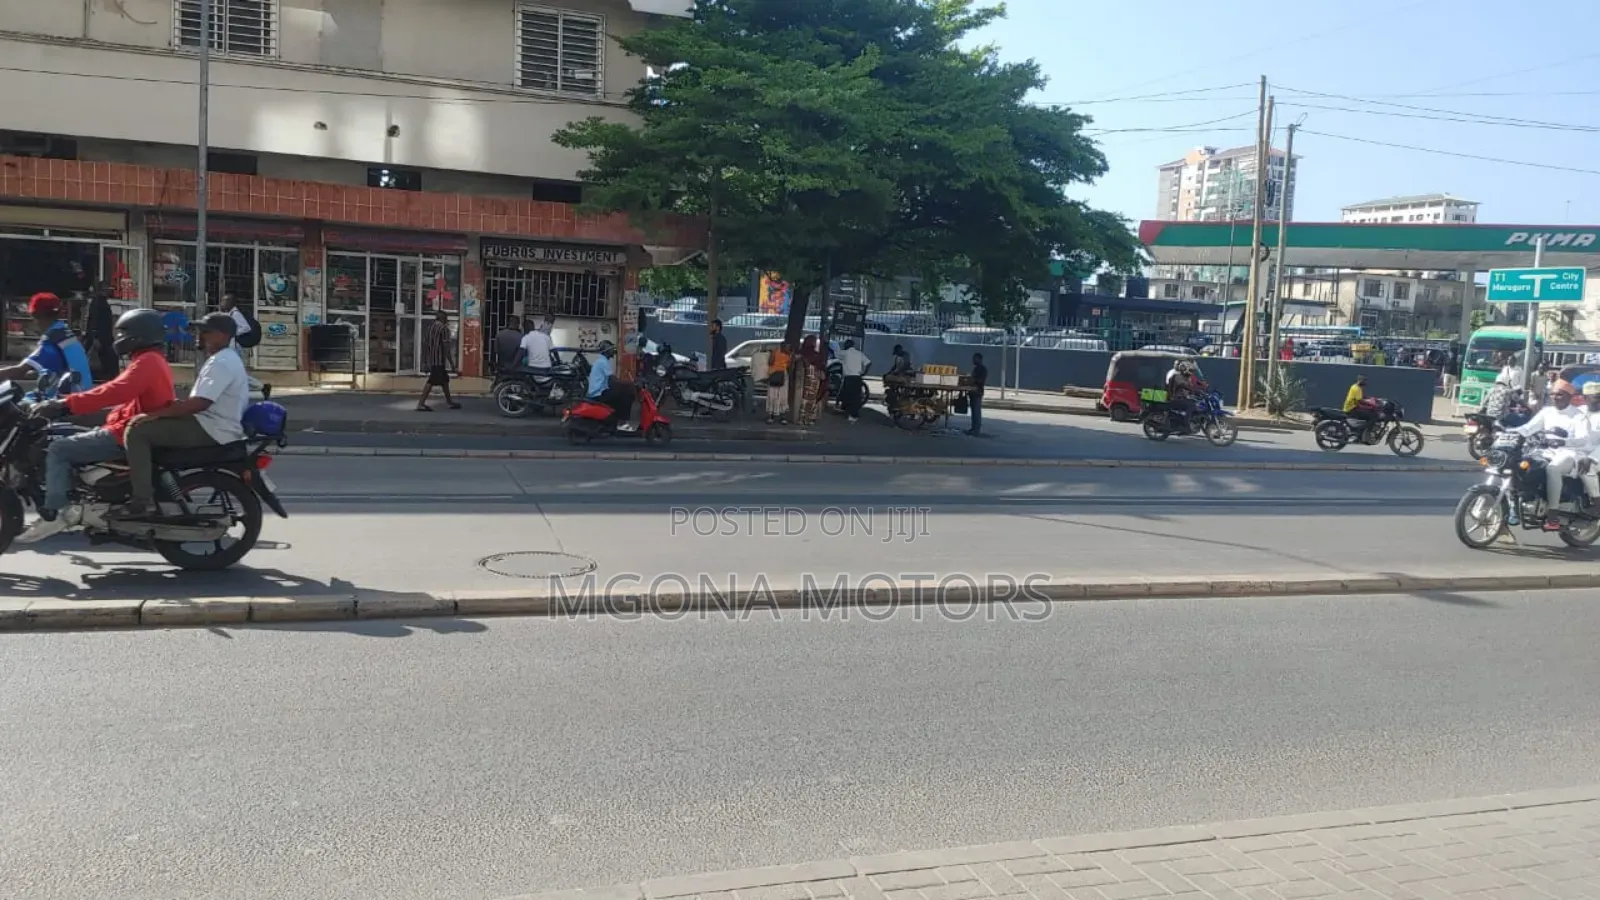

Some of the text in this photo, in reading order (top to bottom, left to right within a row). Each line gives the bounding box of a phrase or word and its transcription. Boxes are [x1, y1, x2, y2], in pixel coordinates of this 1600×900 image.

[1505, 232, 1597, 247] PUMA
[543, 247, 618, 262] INVESTMENT
[1494, 273, 1506, 282] T1
[1562, 272, 1579, 282] City
[1549, 281, 1579, 290] Centre
